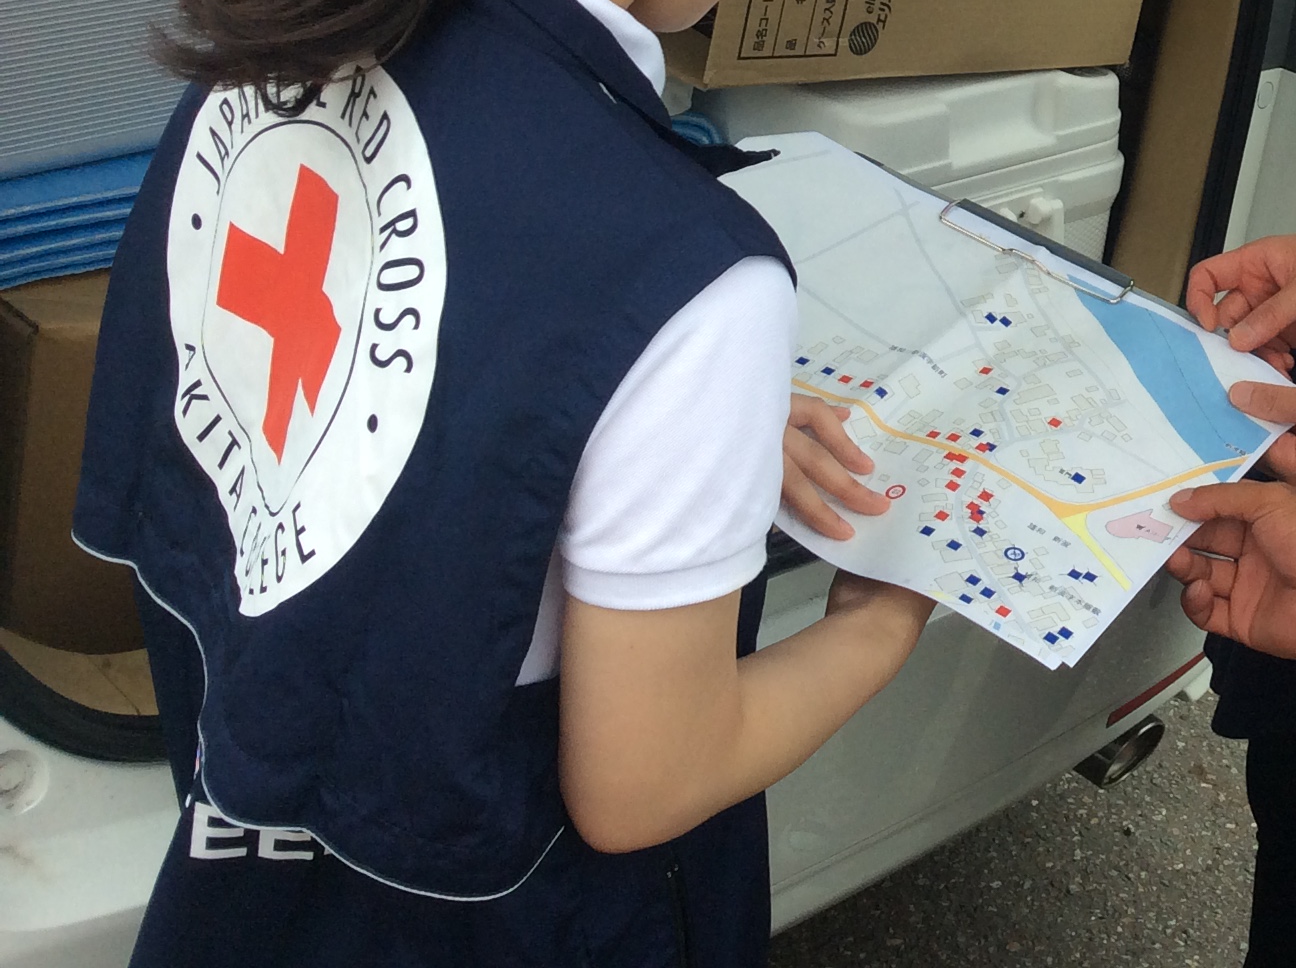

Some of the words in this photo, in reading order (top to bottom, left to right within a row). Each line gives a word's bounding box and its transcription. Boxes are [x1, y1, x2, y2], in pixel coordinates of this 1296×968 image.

[196, 77, 329, 196] JAPANE
[340, 64, 391, 164] RED
[369, 173, 425, 374] CROSS
[181, 342, 244, 513] AKITA
